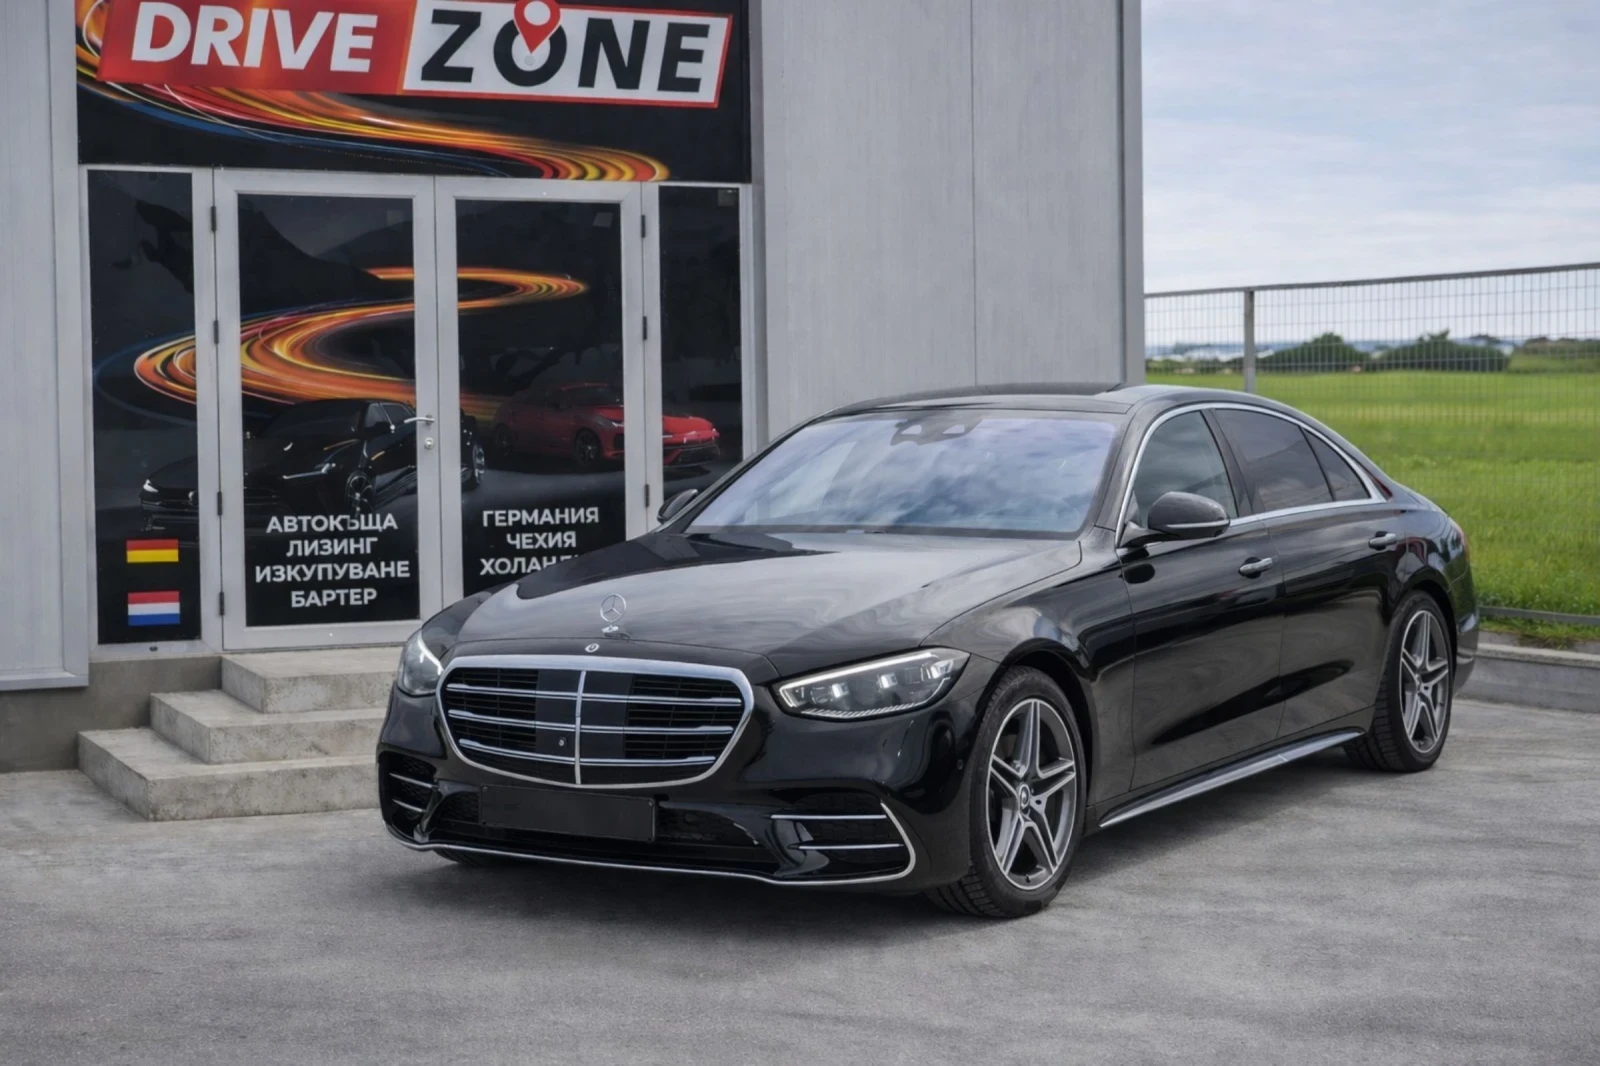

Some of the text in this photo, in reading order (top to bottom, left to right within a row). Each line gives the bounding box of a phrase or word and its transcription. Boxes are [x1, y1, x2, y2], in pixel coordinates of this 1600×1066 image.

[131, 1, 710, 92] DRIVE ZONE
[266, 513, 398, 533] АВТОКЪЩА
[482, 507, 599, 527] ГЕРМАНИЯ
[286, 537, 378, 557] ЛИЗИНГ
[506, 531, 577, 549] ЧЕХИЯ
[255, 561, 410, 583] ИЗКУПУВАНЕ
[479, 555, 579, 576] ХОЛАН
[291, 588, 378, 608] БАРТЕР
